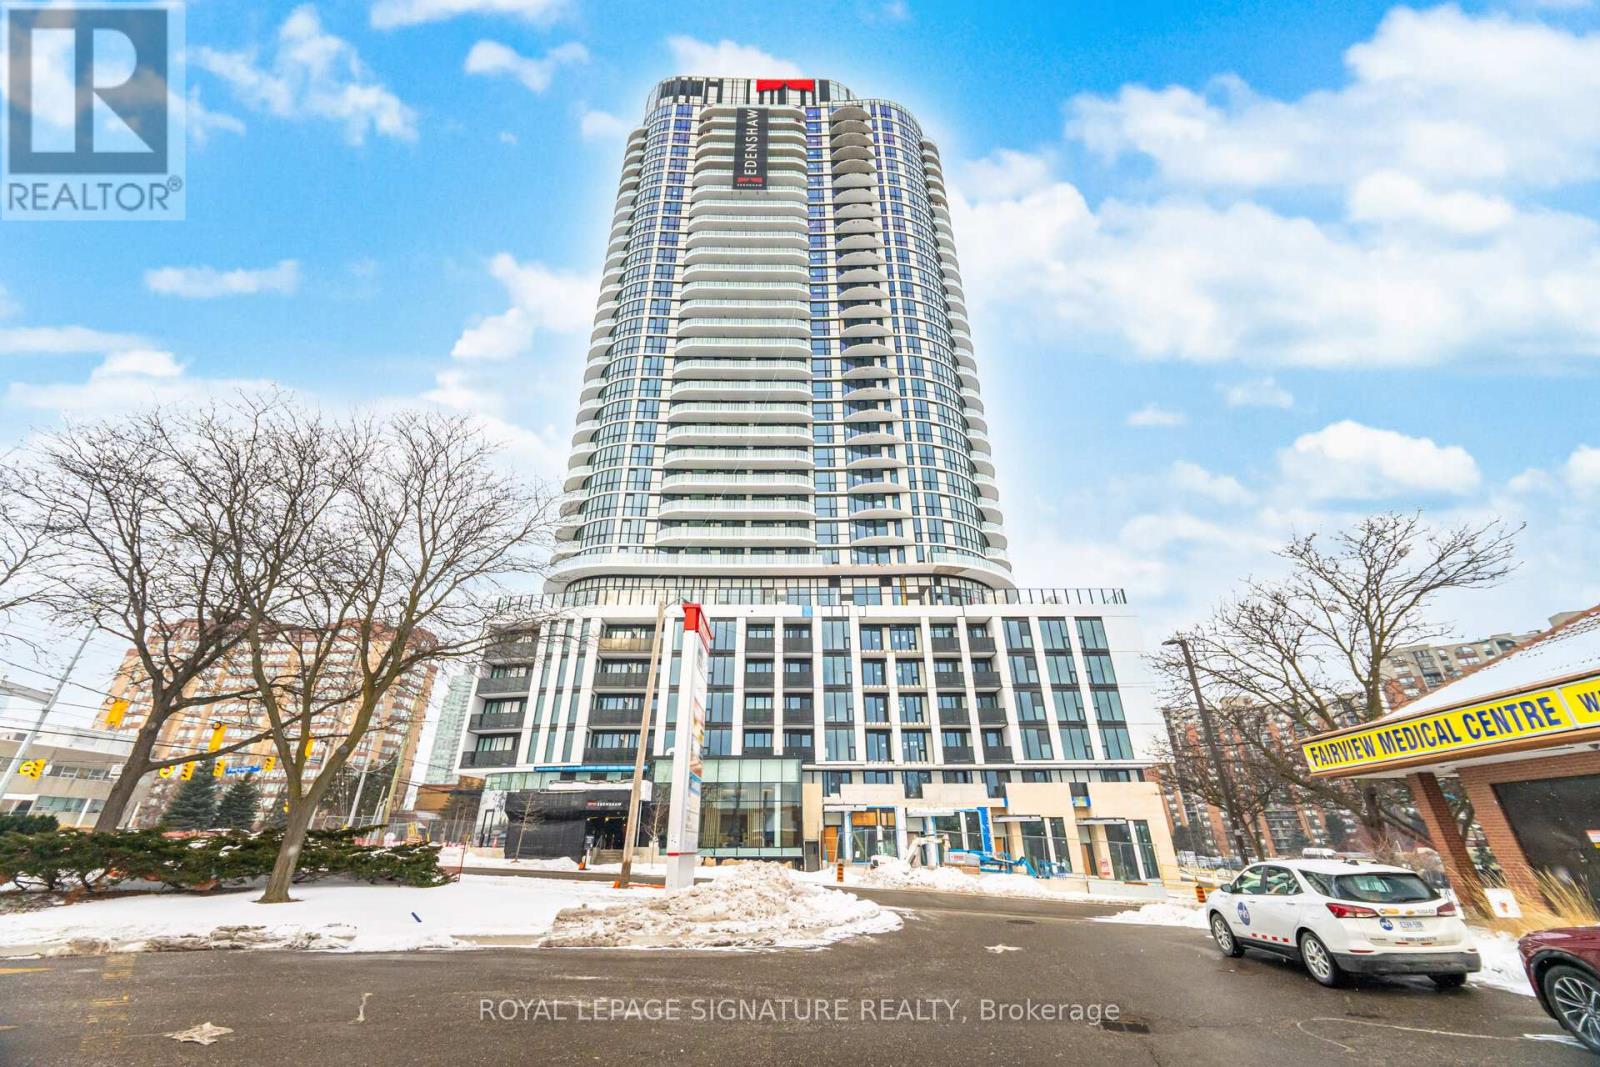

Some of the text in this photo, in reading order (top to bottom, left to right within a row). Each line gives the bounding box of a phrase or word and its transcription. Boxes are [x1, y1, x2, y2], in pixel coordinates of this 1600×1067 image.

[744, 109, 759, 175] EDENSHAW
[1309, 697, 1562, 767] FAIRVIEW MEDICAL CENTRE
[1576, 690, 1600, 713] W
